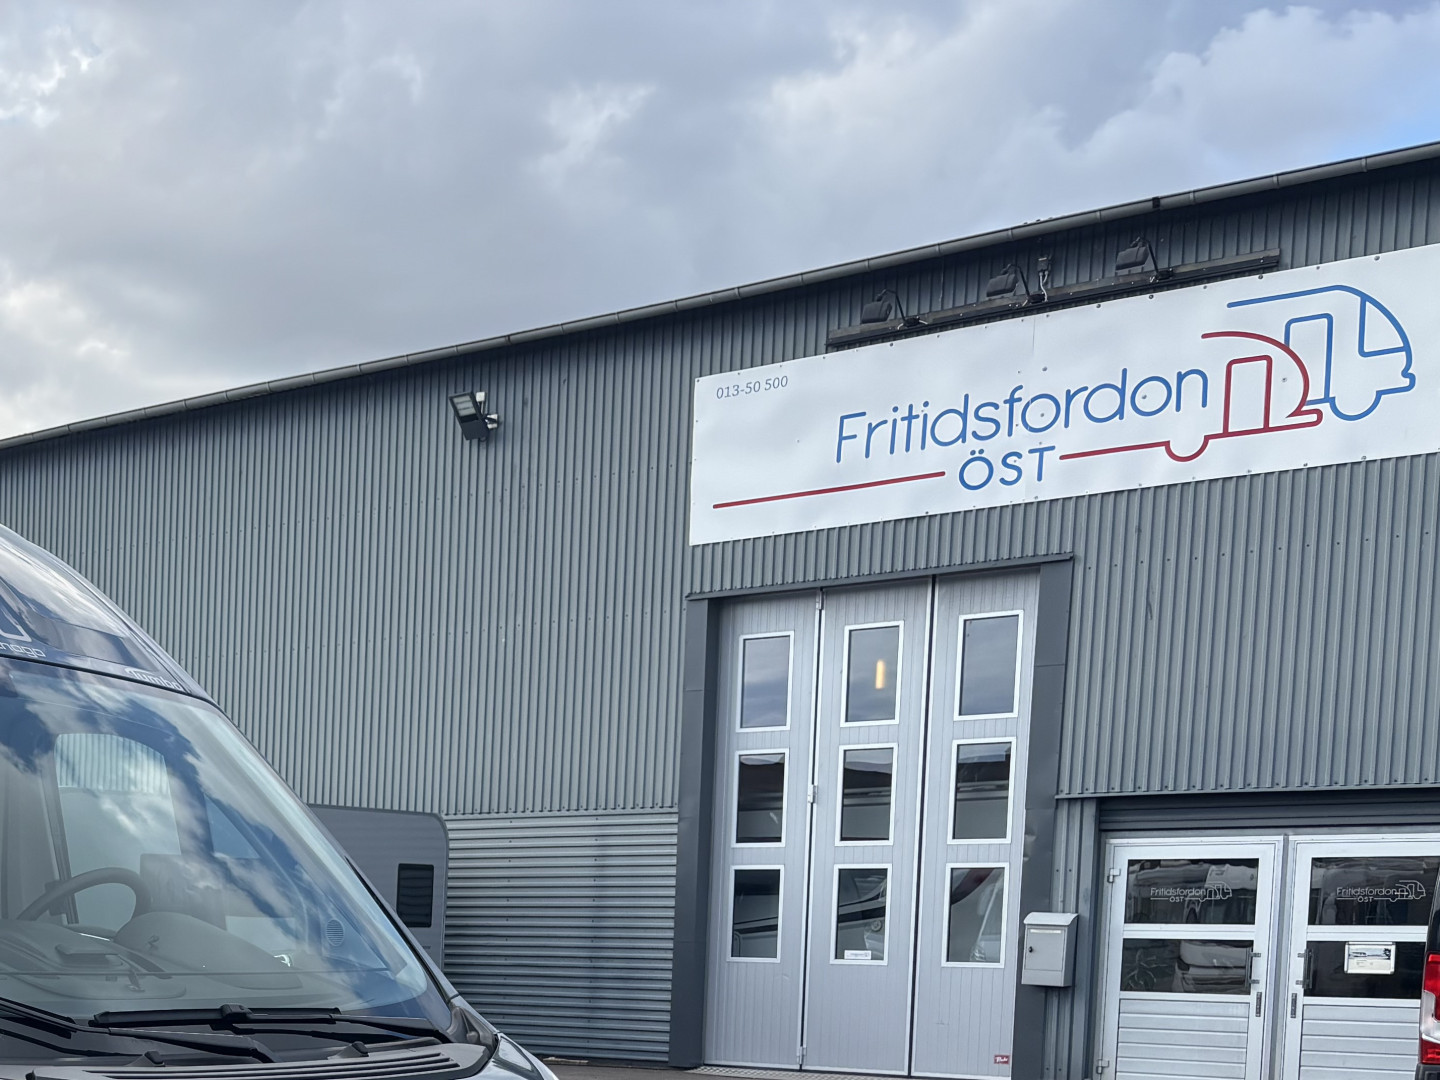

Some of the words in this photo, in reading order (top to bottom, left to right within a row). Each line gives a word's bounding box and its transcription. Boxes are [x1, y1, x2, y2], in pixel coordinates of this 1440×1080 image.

[716, 381, 761, 399] 013-50
[764, 375, 789, 391] 500
[835, 367, 1209, 463] Fritidsfordon
[958, 445, 1056, 491] ÖST
[1150, 887, 1206, 896] Fritidsfordon
[1336, 886, 1396, 896] Fritidsfordon
